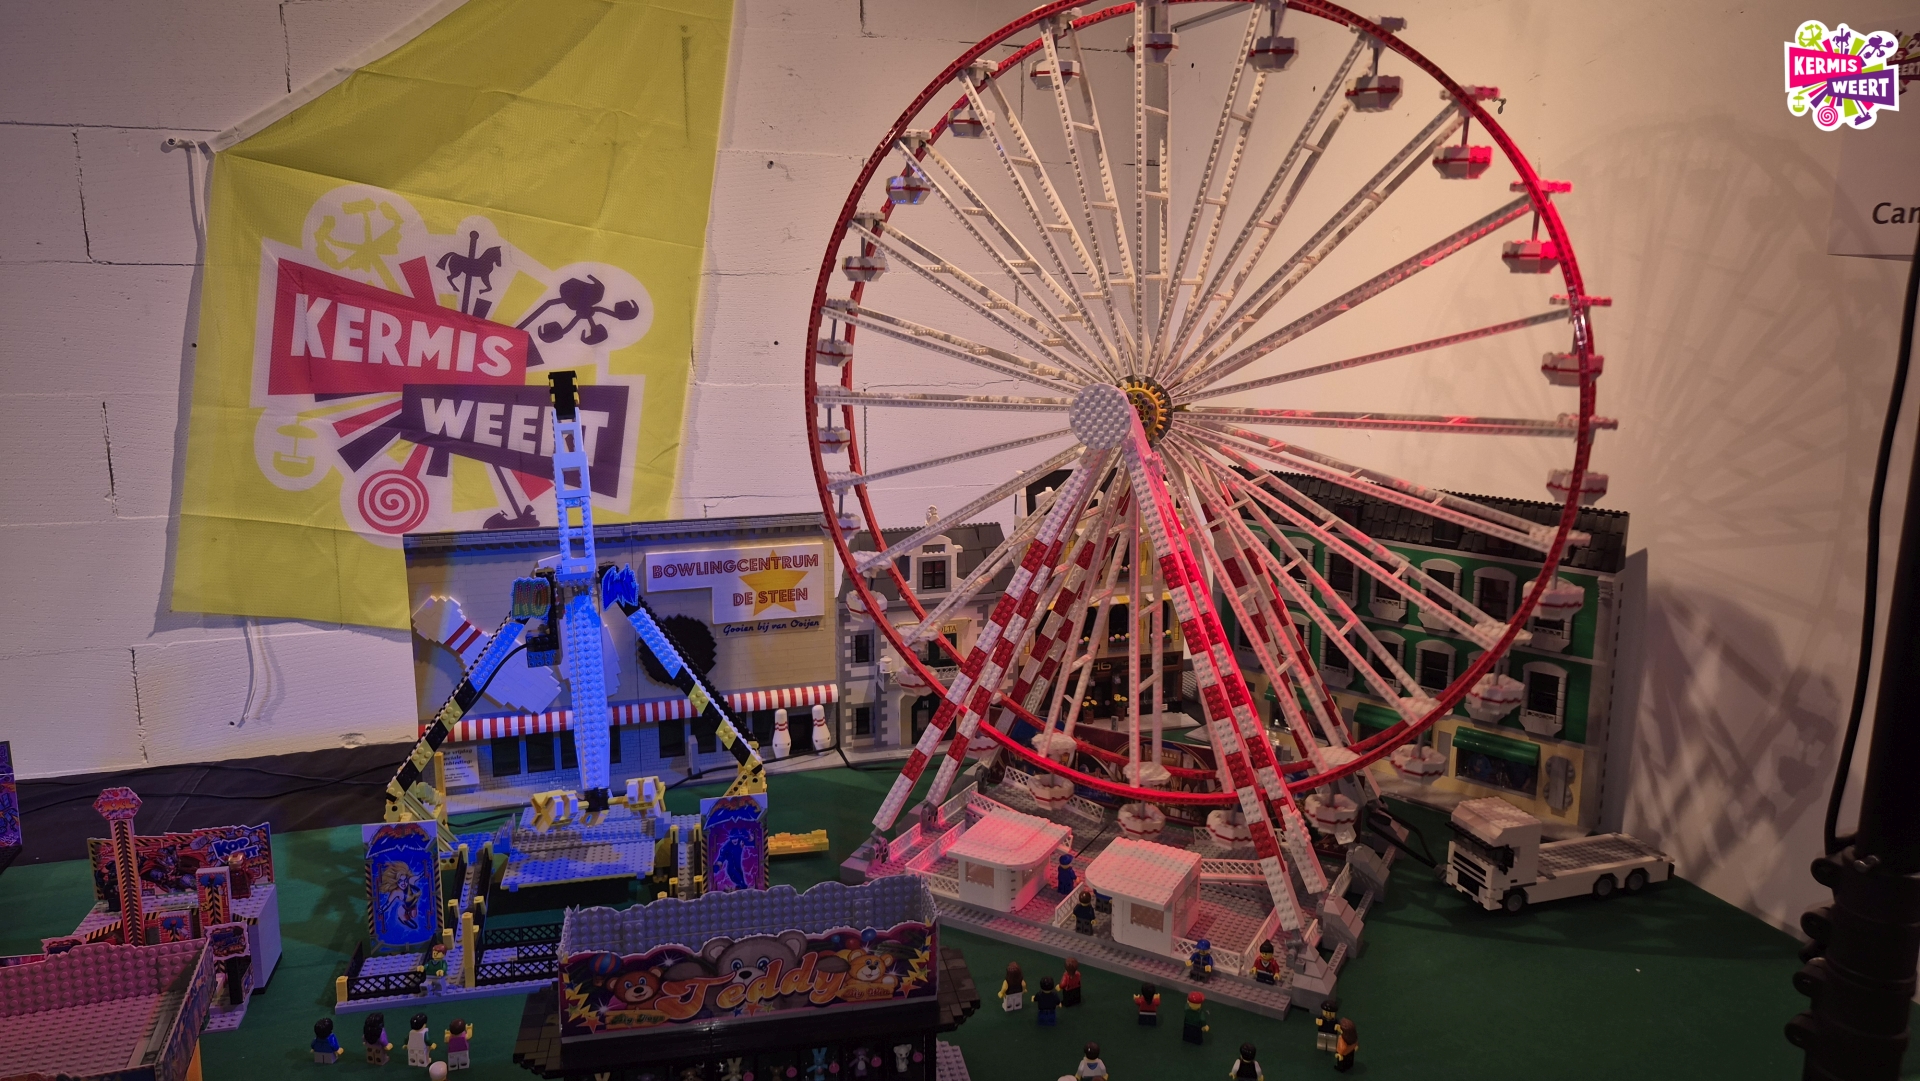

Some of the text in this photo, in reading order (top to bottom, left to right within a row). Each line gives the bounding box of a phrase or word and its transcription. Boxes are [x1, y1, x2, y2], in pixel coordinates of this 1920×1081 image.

[290, 293, 513, 377] KERMIS
[652, 553, 819, 579] BOWLINGCENTRUM
[514, 583, 547, 617] NO
[733, 587, 808, 607] DE STEEN
[723, 624, 754, 636] Gooien
[757, 621, 770, 633] bij
[790, 619, 820, 631] Ooijen
[213, 838, 249, 857] KOP
[654, 952, 850, 1020] Teddy
